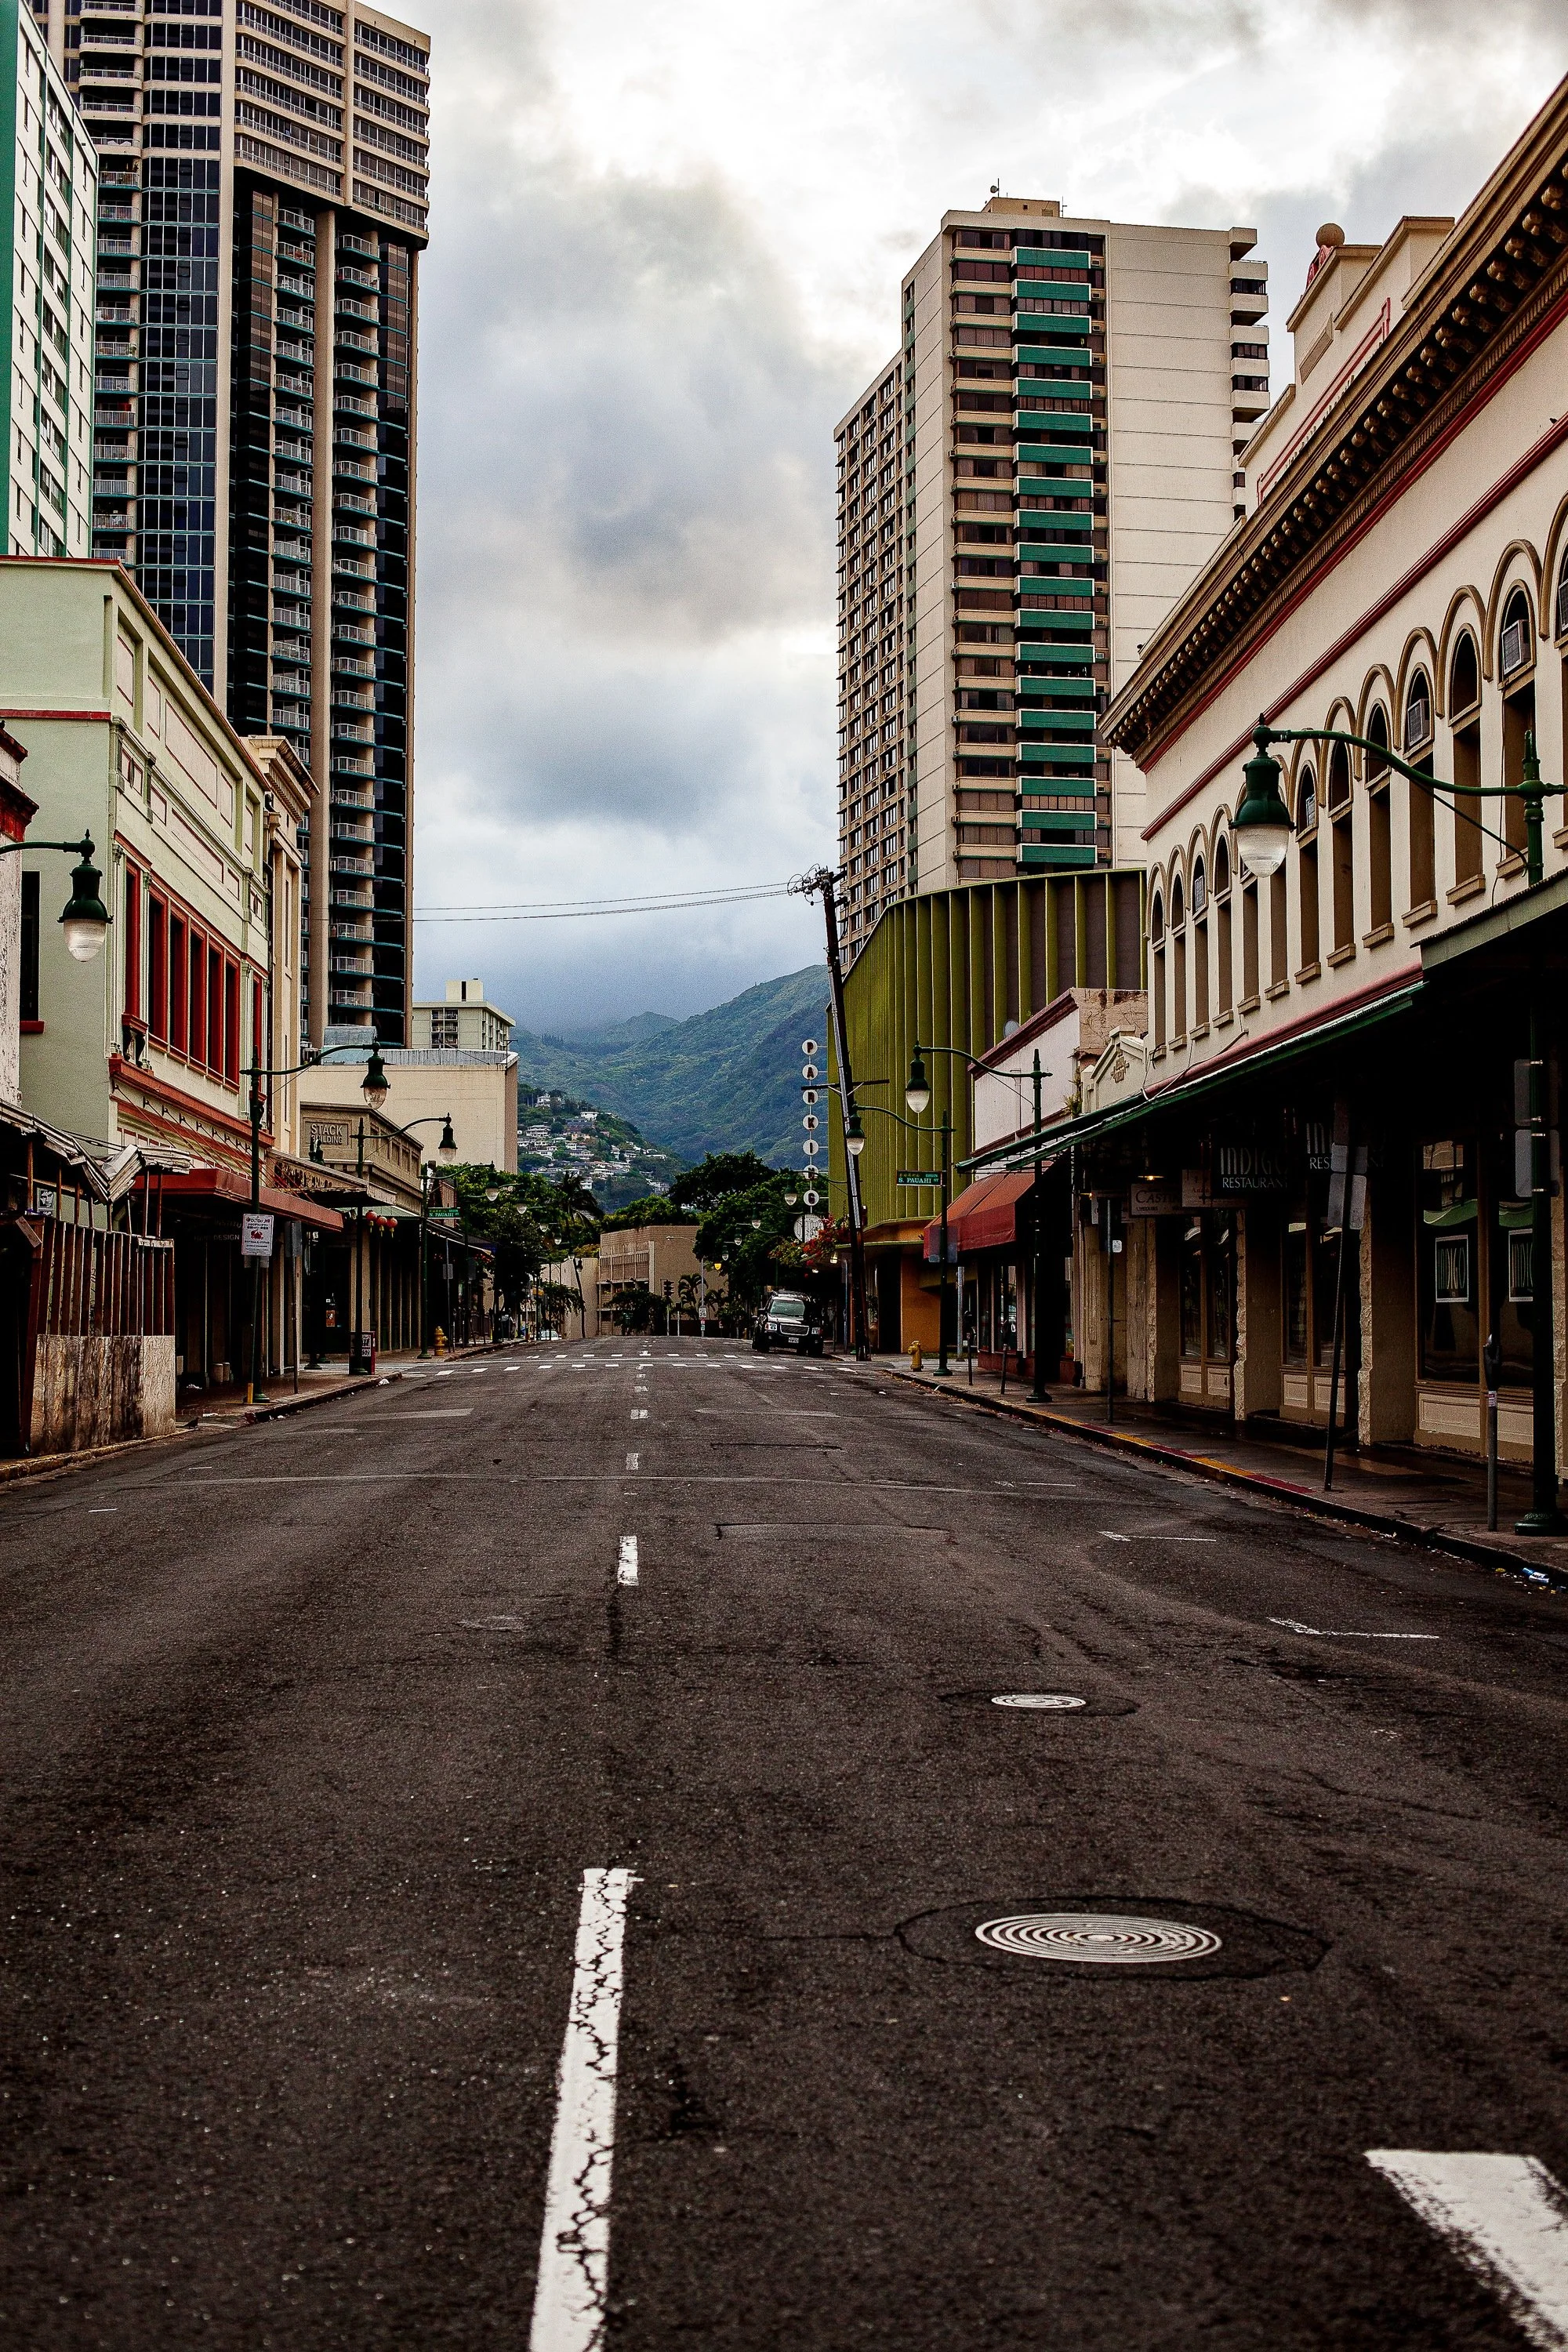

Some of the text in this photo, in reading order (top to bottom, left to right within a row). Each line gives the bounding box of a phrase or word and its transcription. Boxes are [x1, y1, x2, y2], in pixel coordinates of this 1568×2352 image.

[311, 1123, 343, 1136] STACK
[806, 1041, 816, 1205] PARKING
[1438, 1247, 1466, 1290] INDIGO
